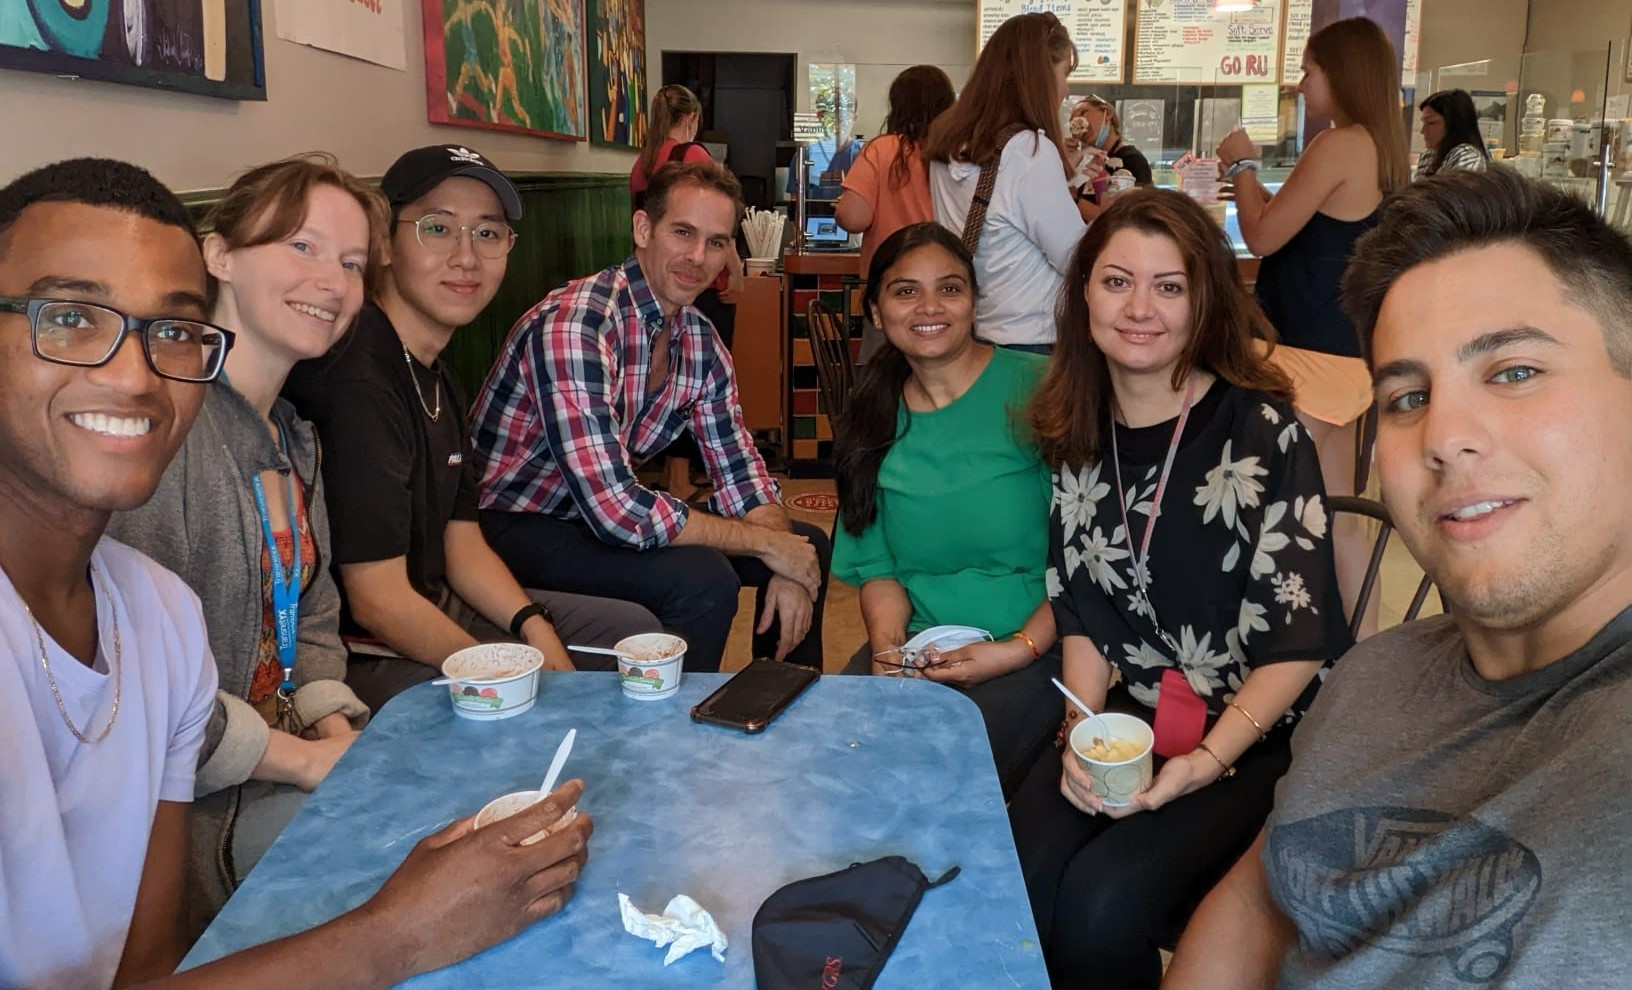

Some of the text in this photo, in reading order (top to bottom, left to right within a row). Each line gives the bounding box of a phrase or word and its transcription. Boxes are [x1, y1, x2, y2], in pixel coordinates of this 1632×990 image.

[1021, 4, 1071, 14] Blend Items
[1227, 24, 1247, 36] Soft
[1248, 23, 1274, 36] Serve
[1220, 54, 1268, 77] GO RU
[450, 156, 484, 166] adidas
